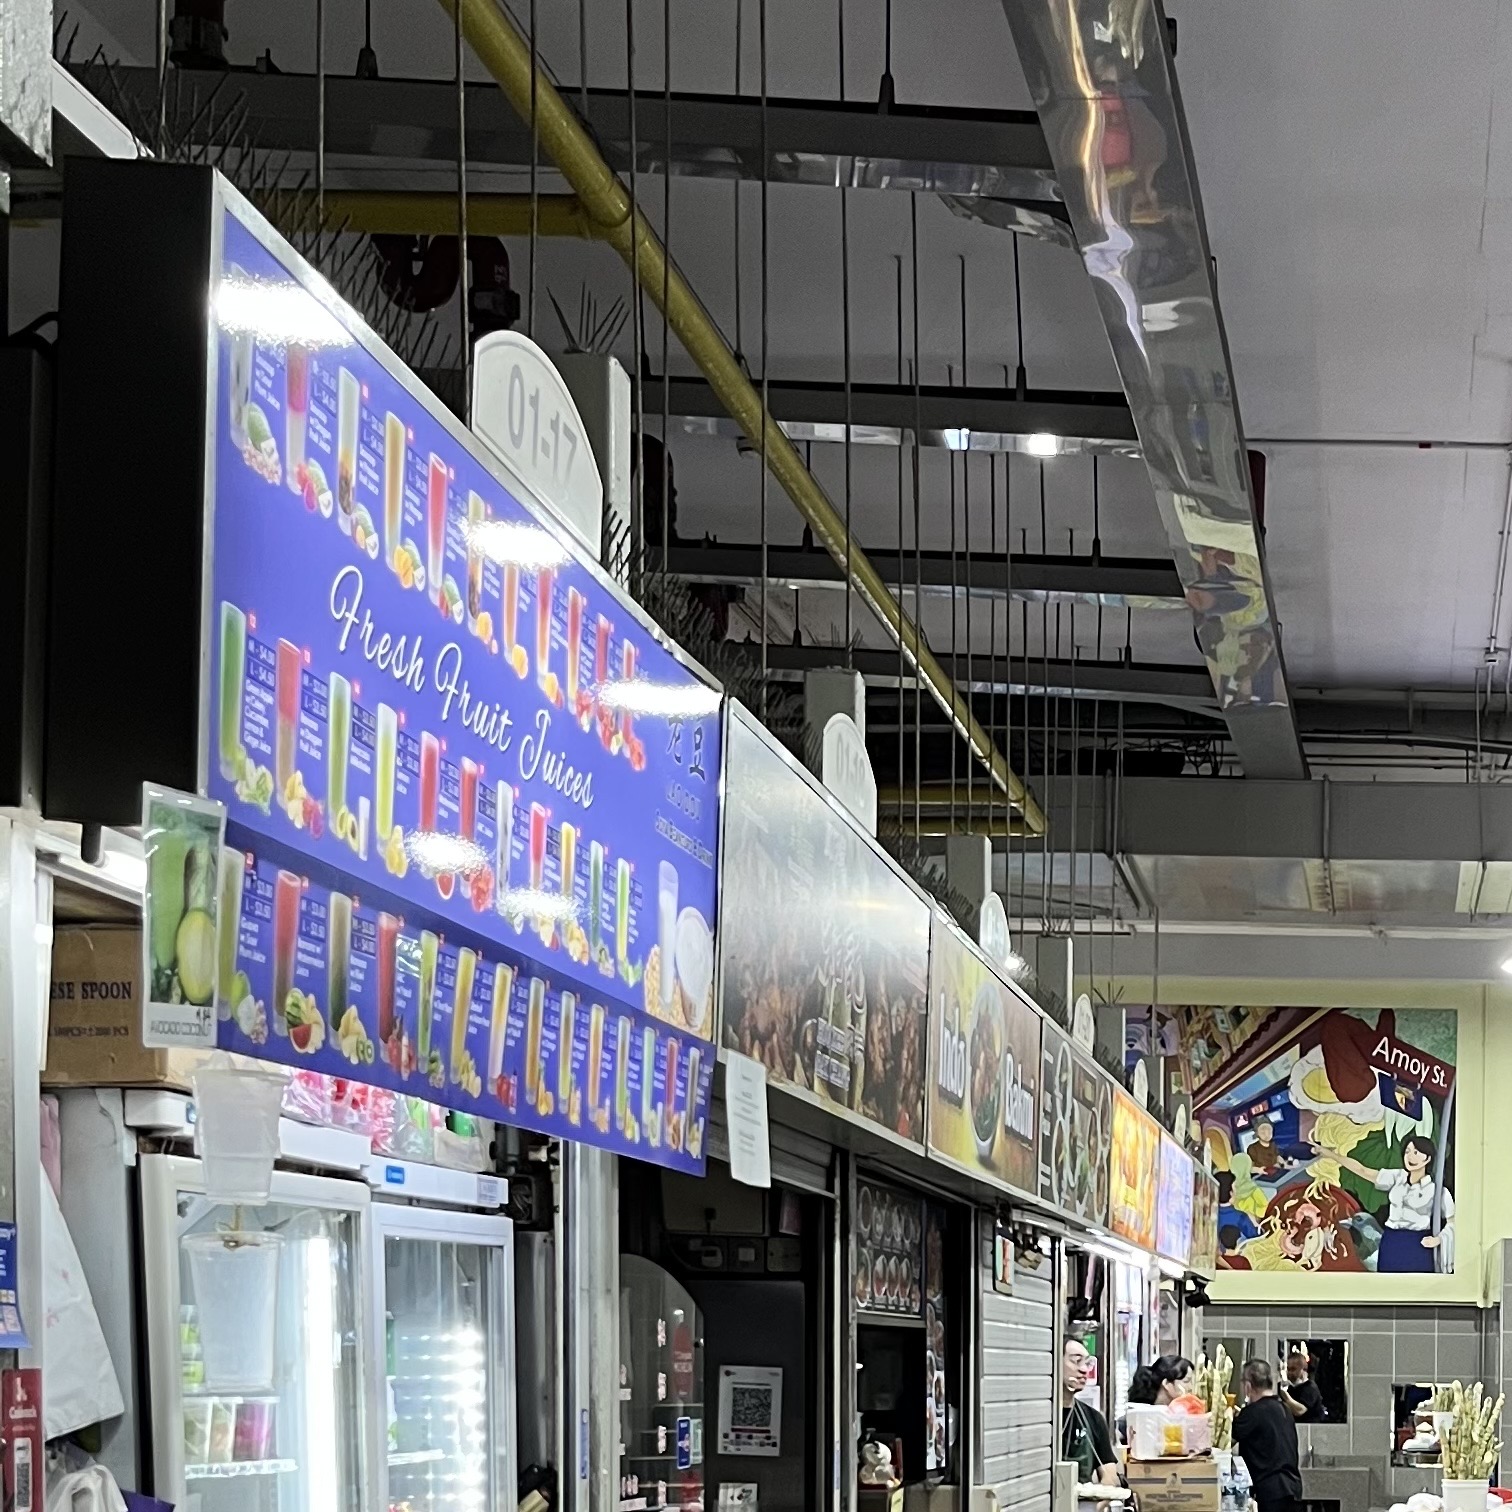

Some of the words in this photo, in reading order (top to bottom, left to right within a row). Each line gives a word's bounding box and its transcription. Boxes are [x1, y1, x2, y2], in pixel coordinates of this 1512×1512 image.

[508, 363, 578, 487] 01-17
[330, 566, 425, 692] Fresh
[435, 642, 514, 751] Fruit
[520, 709, 594, 808] Juices
[81, 981, 133, 1000] SPOON
[938, 992, 966, 1099] Indo
[1372, 1037, 1430, 1085] Amoy
[1431, 1065, 1448, 1088] St.
